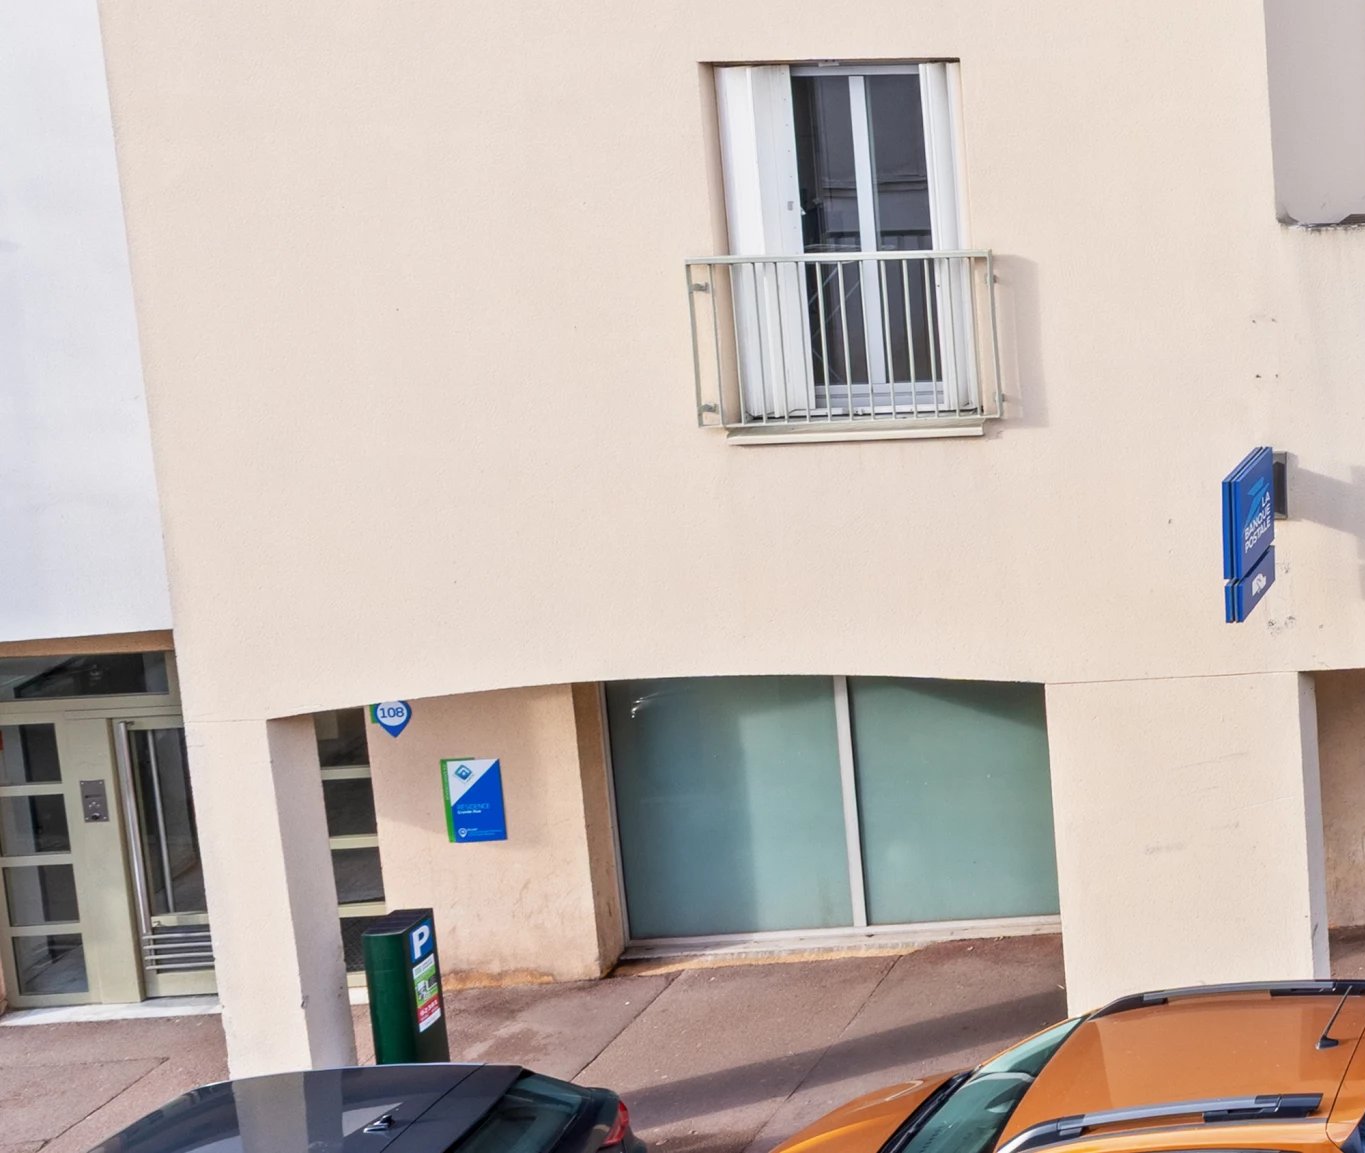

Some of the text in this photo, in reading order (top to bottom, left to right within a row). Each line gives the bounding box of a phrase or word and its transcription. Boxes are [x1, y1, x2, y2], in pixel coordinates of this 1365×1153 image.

[1262, 491, 1271, 508] LA
[1245, 503, 1271, 540] BANQUE
[1245, 515, 1271, 554] POSTALE
[380, 707, 405, 718] 108
[412, 925, 430, 960] P
